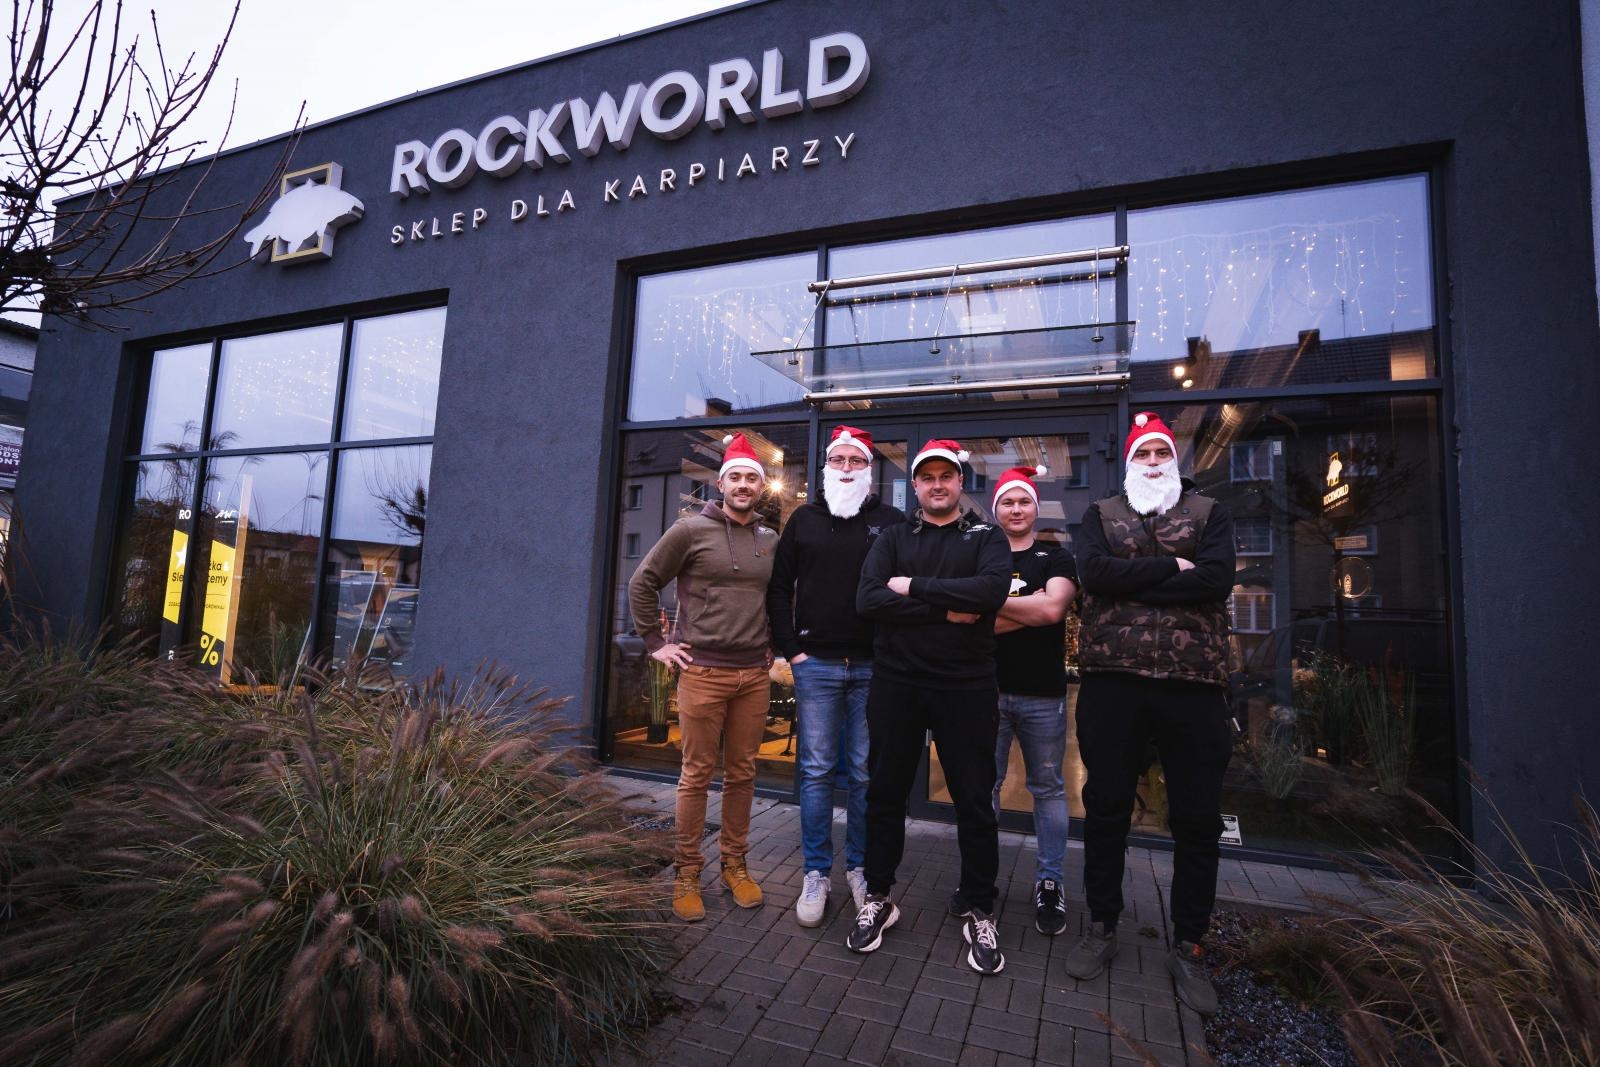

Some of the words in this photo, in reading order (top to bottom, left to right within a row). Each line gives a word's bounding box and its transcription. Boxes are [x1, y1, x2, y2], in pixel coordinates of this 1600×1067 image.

[390, 31, 870, 198] ROCKWORLD
[390, 208, 488, 245] SKLEP
[511, 189, 576, 222] DLA
[604, 132, 856, 203] KARPIARZY
[178, 509, 191, 519] RO
[171, 572, 184, 582] Sle
